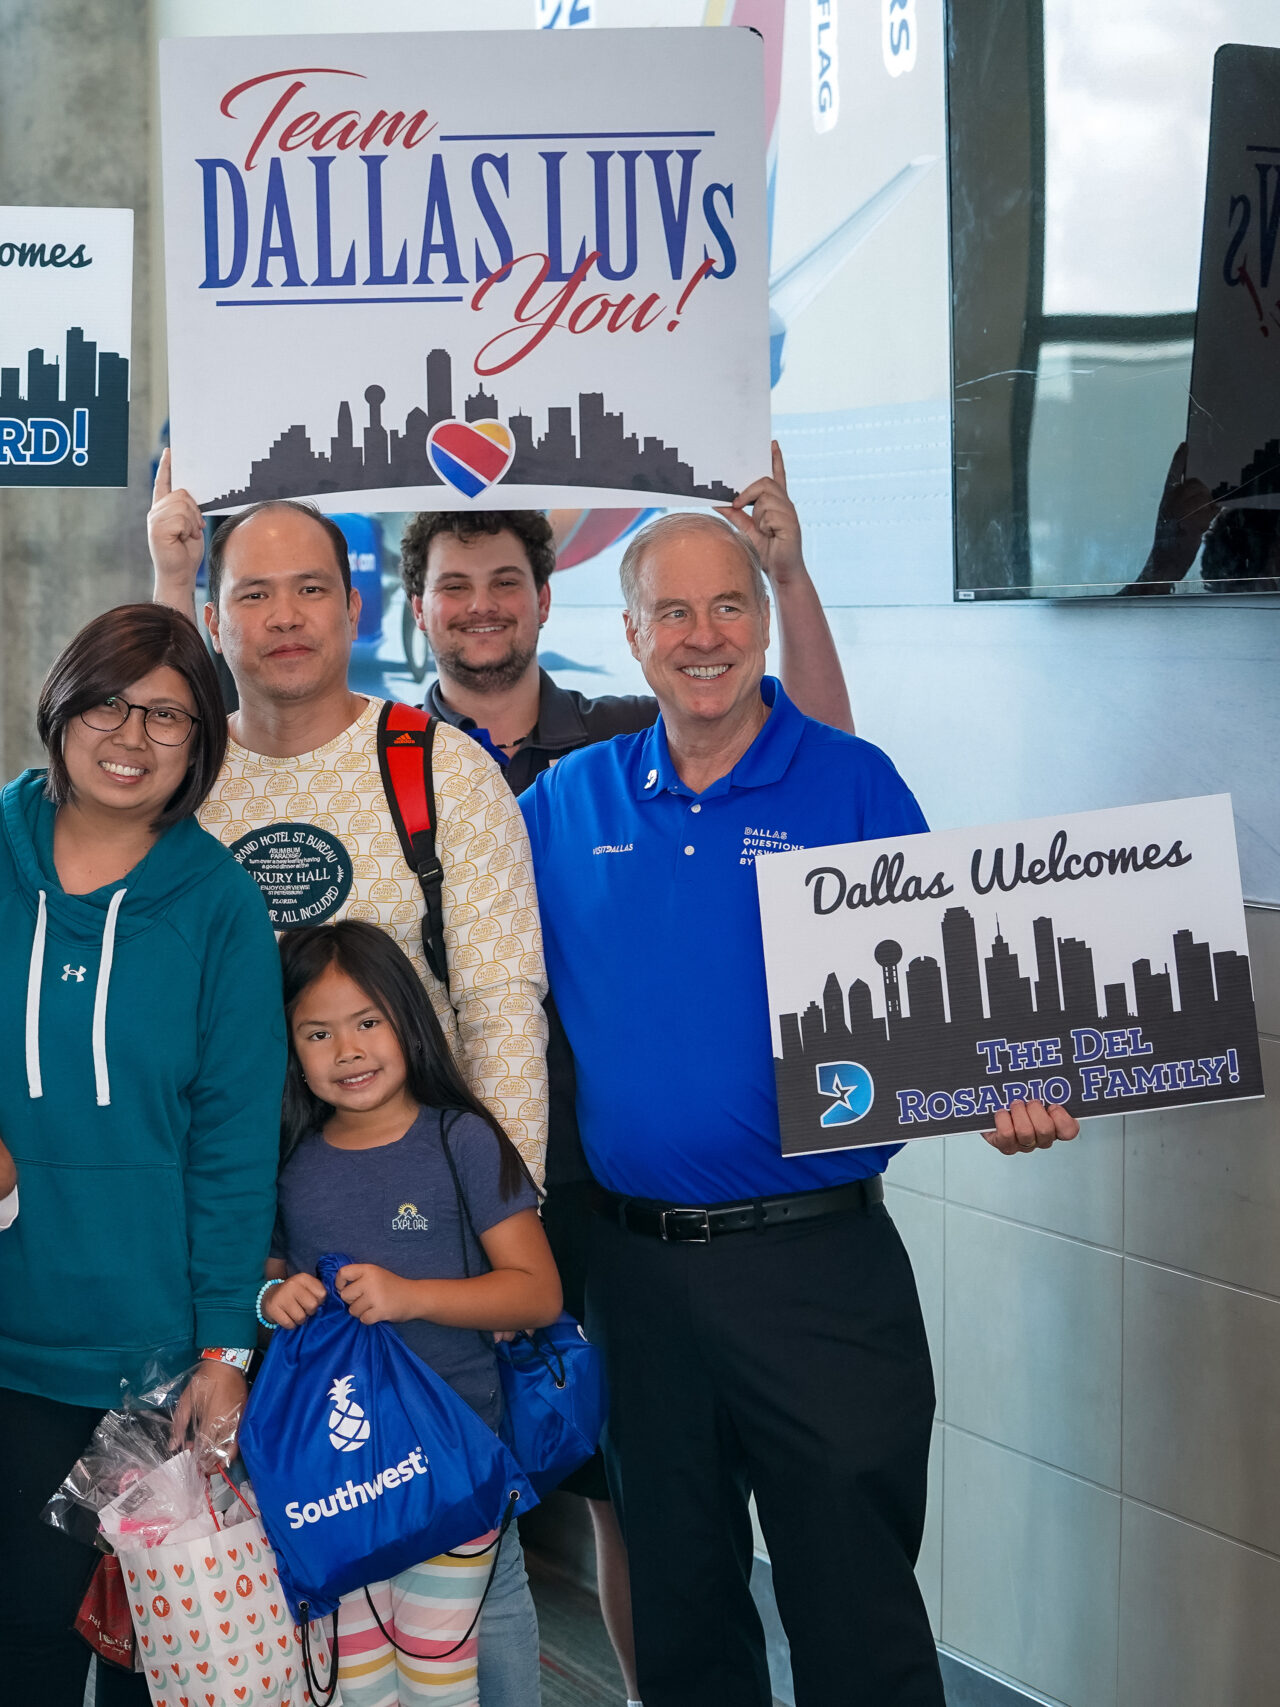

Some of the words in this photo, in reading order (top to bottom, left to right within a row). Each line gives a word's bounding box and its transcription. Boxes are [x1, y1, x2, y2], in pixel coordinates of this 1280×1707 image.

[220, 68, 439, 171] Team
[195, 152, 514, 289] DALLAS
[470, 250, 717, 376] You!
[234, 841, 259, 865] RAND
[260, 832, 291, 847] HOTEL
[306, 834, 339, 864] BUREAU
[743, 838, 805, 852] QUESTIONS
[744, 826, 788, 840] DALLAS
[253, 871, 293, 884] XURY
[296, 868, 330, 883] HALL
[740, 857, 754, 866] BY
[805, 851, 954, 915] Dallas
[970, 829, 1192, 893] Welcomes
[281, 910, 300, 922] ALL
[300, 886, 339, 921] INCLUDED
[976, 1038, 1063, 1074] THE
[1070, 1027, 1153, 1064] DEL
[897, 1076, 1071, 1124] ROSARIO
[1079, 1048, 1240, 1102] FAMILY!
[392, 1219, 429, 1230] EXPLORE
[285, 1448, 428, 1530] Southwest
